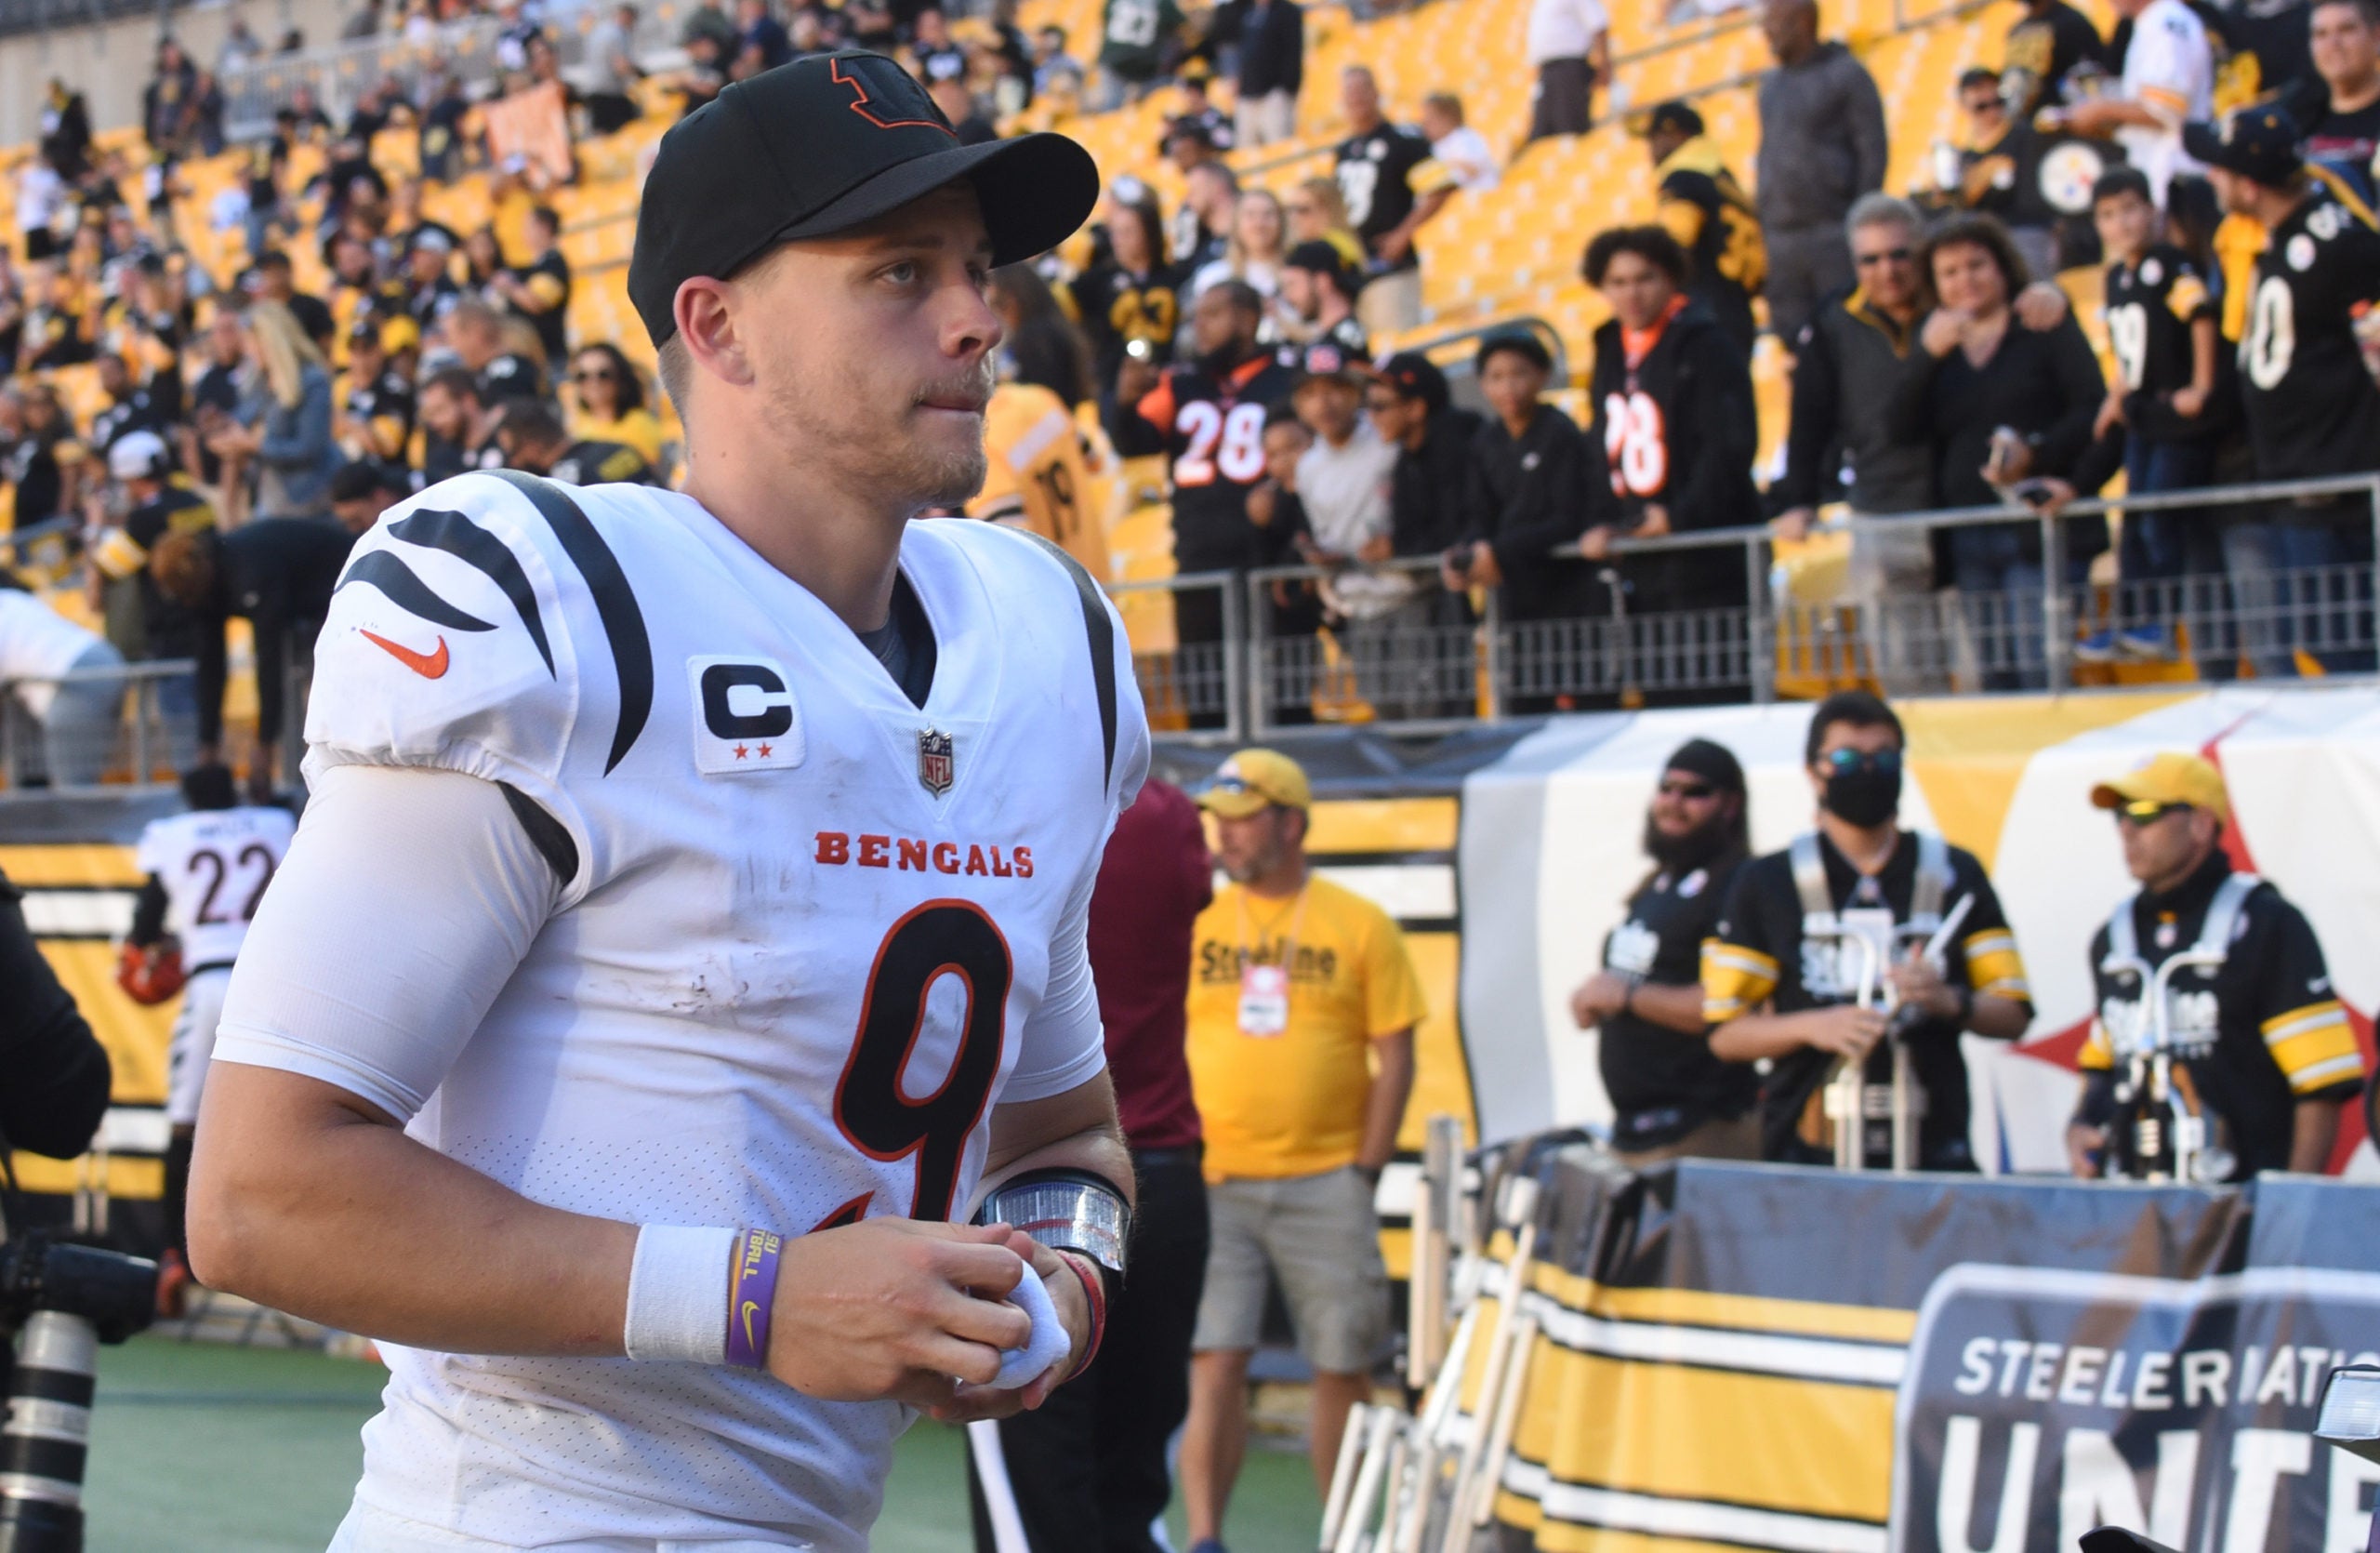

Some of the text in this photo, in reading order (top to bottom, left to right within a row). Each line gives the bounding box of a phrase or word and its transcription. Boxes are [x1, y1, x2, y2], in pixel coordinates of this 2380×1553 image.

[1173, 400, 1267, 488] 28
[700, 663, 794, 740] C
[923, 754, 951, 785] NFL
[188, 844, 277, 926] 22
[814, 830, 1035, 880] BENGALS
[807, 897, 1012, 1235] 9
[1954, 1336, 2233, 1410] STEELER
